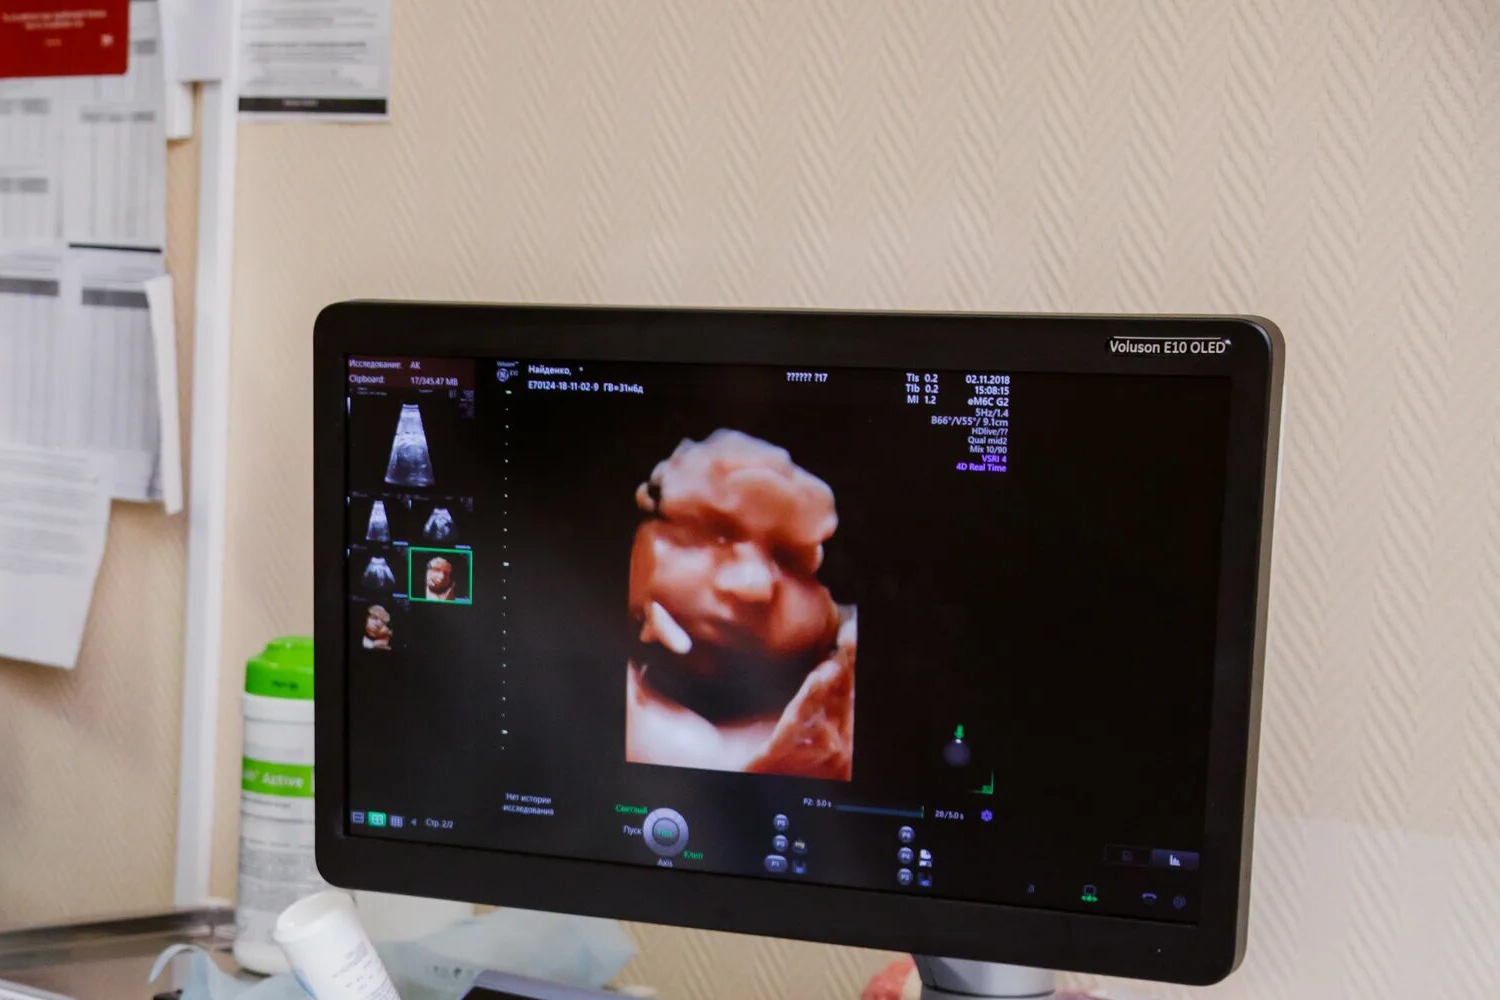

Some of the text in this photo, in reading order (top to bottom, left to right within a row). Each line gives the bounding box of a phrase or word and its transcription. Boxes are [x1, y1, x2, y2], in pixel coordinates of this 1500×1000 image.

[1110, 340, 1226, 354] Voluson E10 OLED
[446, 378, 458, 386] MB
[924, 374, 938, 383] 0.2
[965, 375, 1010, 385] 02.11.2018
[925, 384, 938, 393] 0.2
[975, 386, 1010, 395] 15:08:15
[924, 395, 937, 404] 1.2
[967, 397, 1009, 407] eM6C G2
[975, 408, 1009, 418] 5Hz/1.4
[983, 417, 1008, 426] 9.1cm
[967, 436, 1007, 445] Qual mid2
[970, 445, 1007, 454] Mix 10/90
[1002, 455, 1007, 463] 4
[956, 462, 1007, 472] 4D Real Time
[262, 772, 304, 788] Active
[442, 820, 454, 828] 2/2
[623, 825, 642, 836] Пуск
